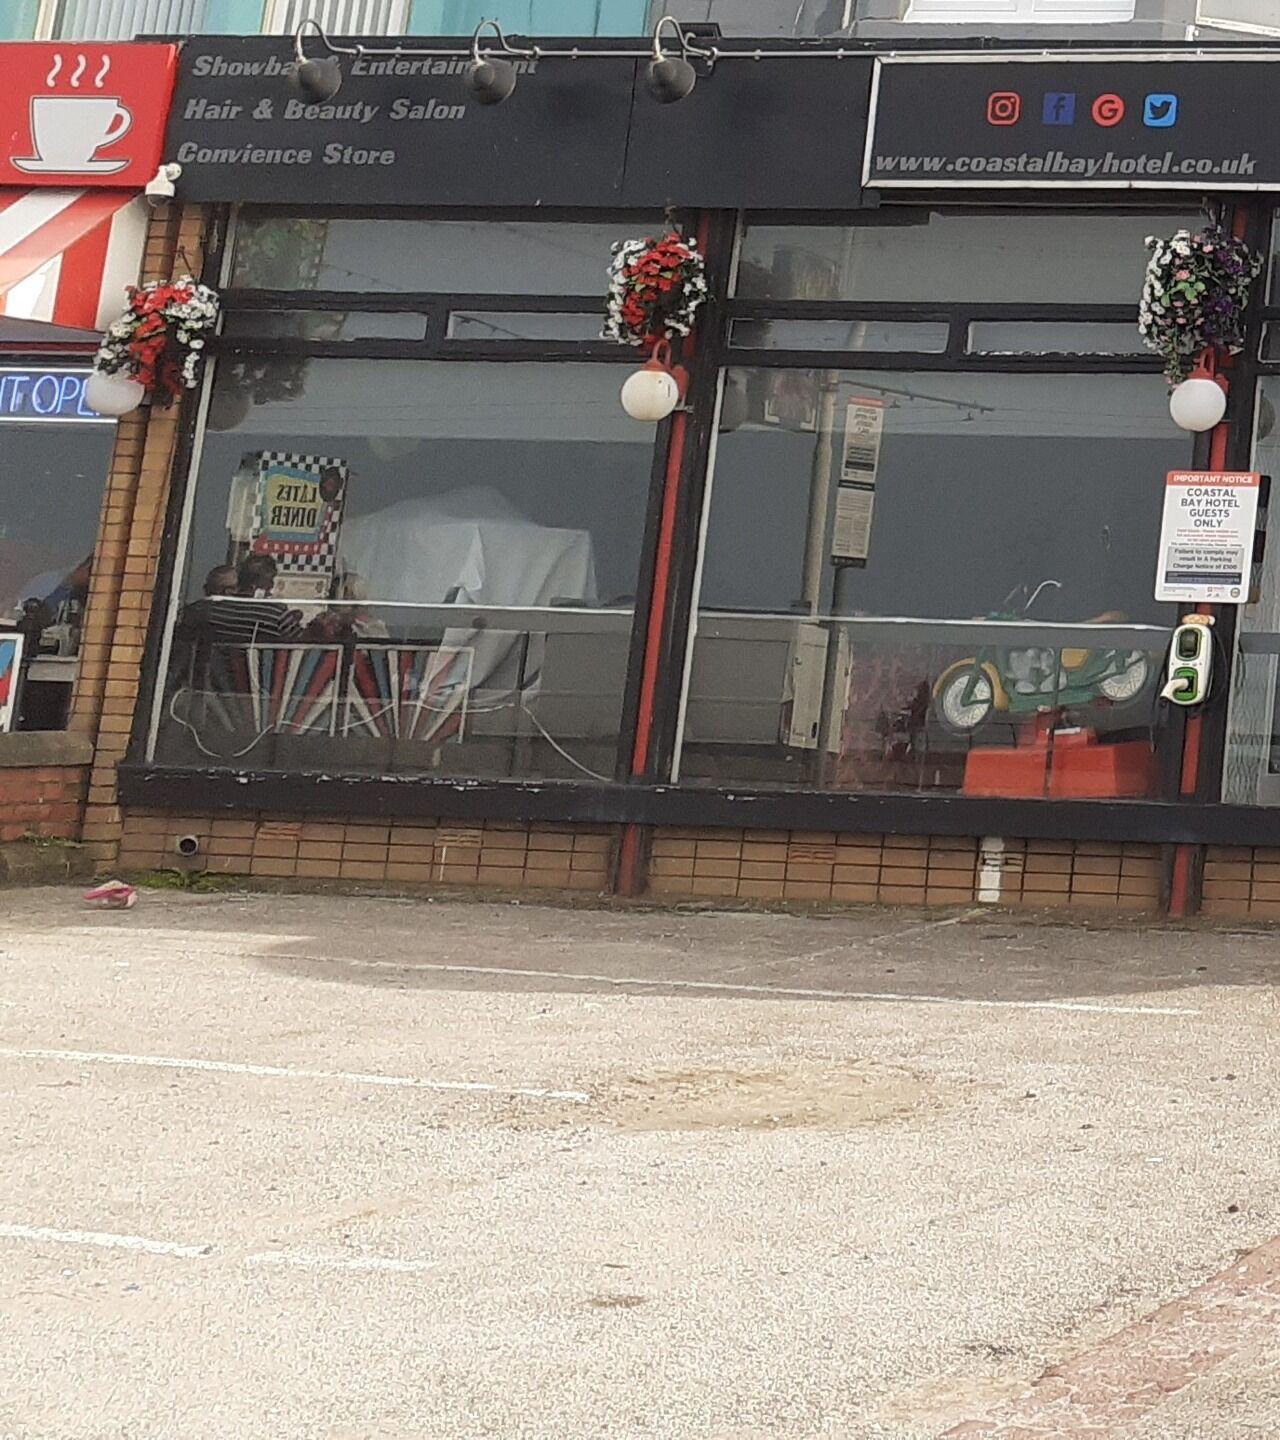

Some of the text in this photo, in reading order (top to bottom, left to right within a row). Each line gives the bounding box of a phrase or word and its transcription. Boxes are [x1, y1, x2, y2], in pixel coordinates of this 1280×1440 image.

[192, 55, 299, 77] Showba
[184, 98, 466, 123] Hair & Beauty Salon
[177, 141, 395, 165] Convience Store
[875, 151, 1257, 177] www.coastalbayhotel.co.uk
[32, 375, 99, 417] OPE
[1173, 474, 1253, 484] IMPORTANT NOTICE
[1187, 488, 1236, 497] COASTAL
[1181, 498, 1240, 508] BAY HOTEL
[1189, 509, 1230, 518] GUESTS
[1194, 519, 1223, 528] ONLY
